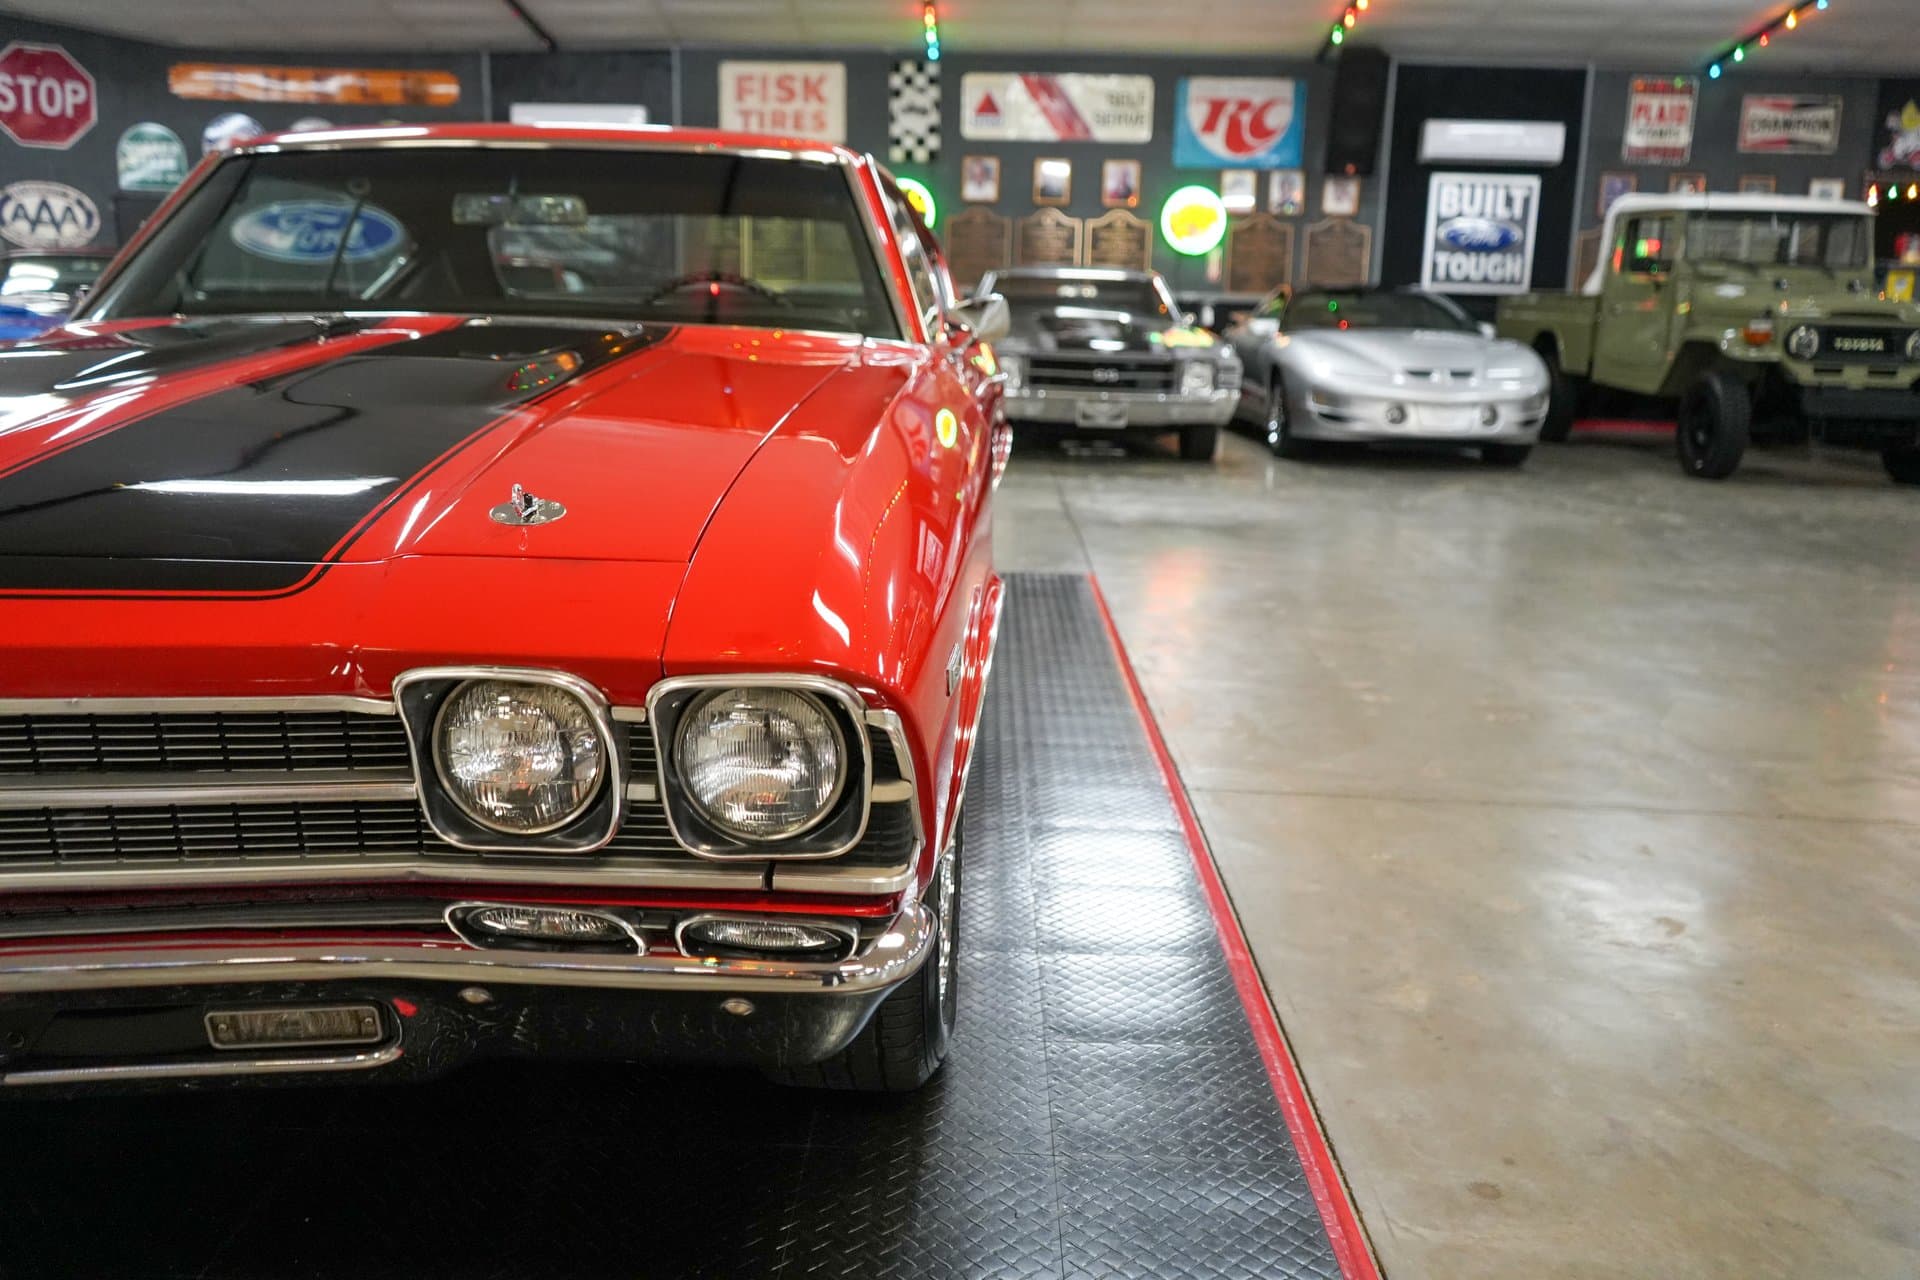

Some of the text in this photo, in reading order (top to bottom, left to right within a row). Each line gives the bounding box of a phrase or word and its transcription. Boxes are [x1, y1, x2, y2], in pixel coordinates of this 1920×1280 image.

[0, 71, 88, 118] STOP
[735, 75, 827, 103] FISK
[738, 110, 826, 132] TIRES
[1195, 97, 1293, 154] RC
[11, 199, 79, 232] AAA
[1440, 184, 1532, 219] BUILT
[1434, 251, 1523, 282] TOUGH
